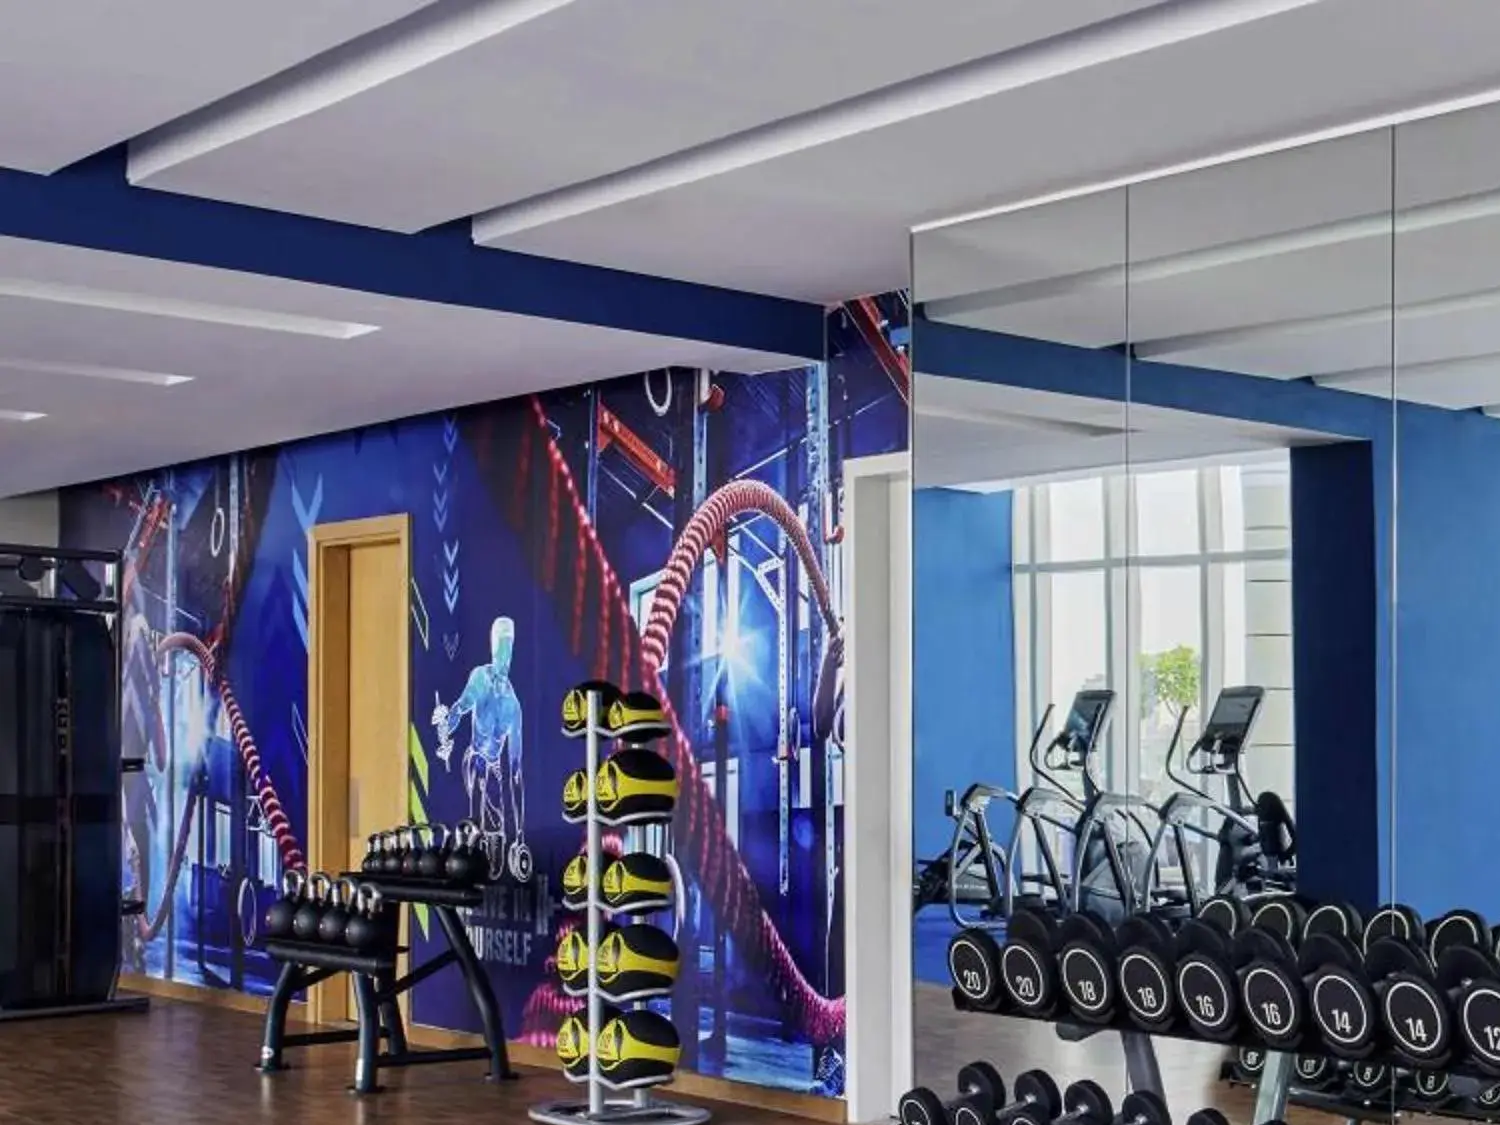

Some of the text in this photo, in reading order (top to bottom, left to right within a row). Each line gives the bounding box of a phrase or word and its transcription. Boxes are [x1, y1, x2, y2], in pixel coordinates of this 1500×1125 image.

[963, 970, 981, 991] 20
[1015, 975, 1034, 997] 20
[1078, 980, 1096, 1003] 18
[1138, 987, 1157, 1009] 18
[1195, 994, 1215, 1018] 16
[1262, 1003, 1281, 1026] 16
[1331, 1008, 1352, 1033] 14
[1405, 1017, 1427, 1042] 14
